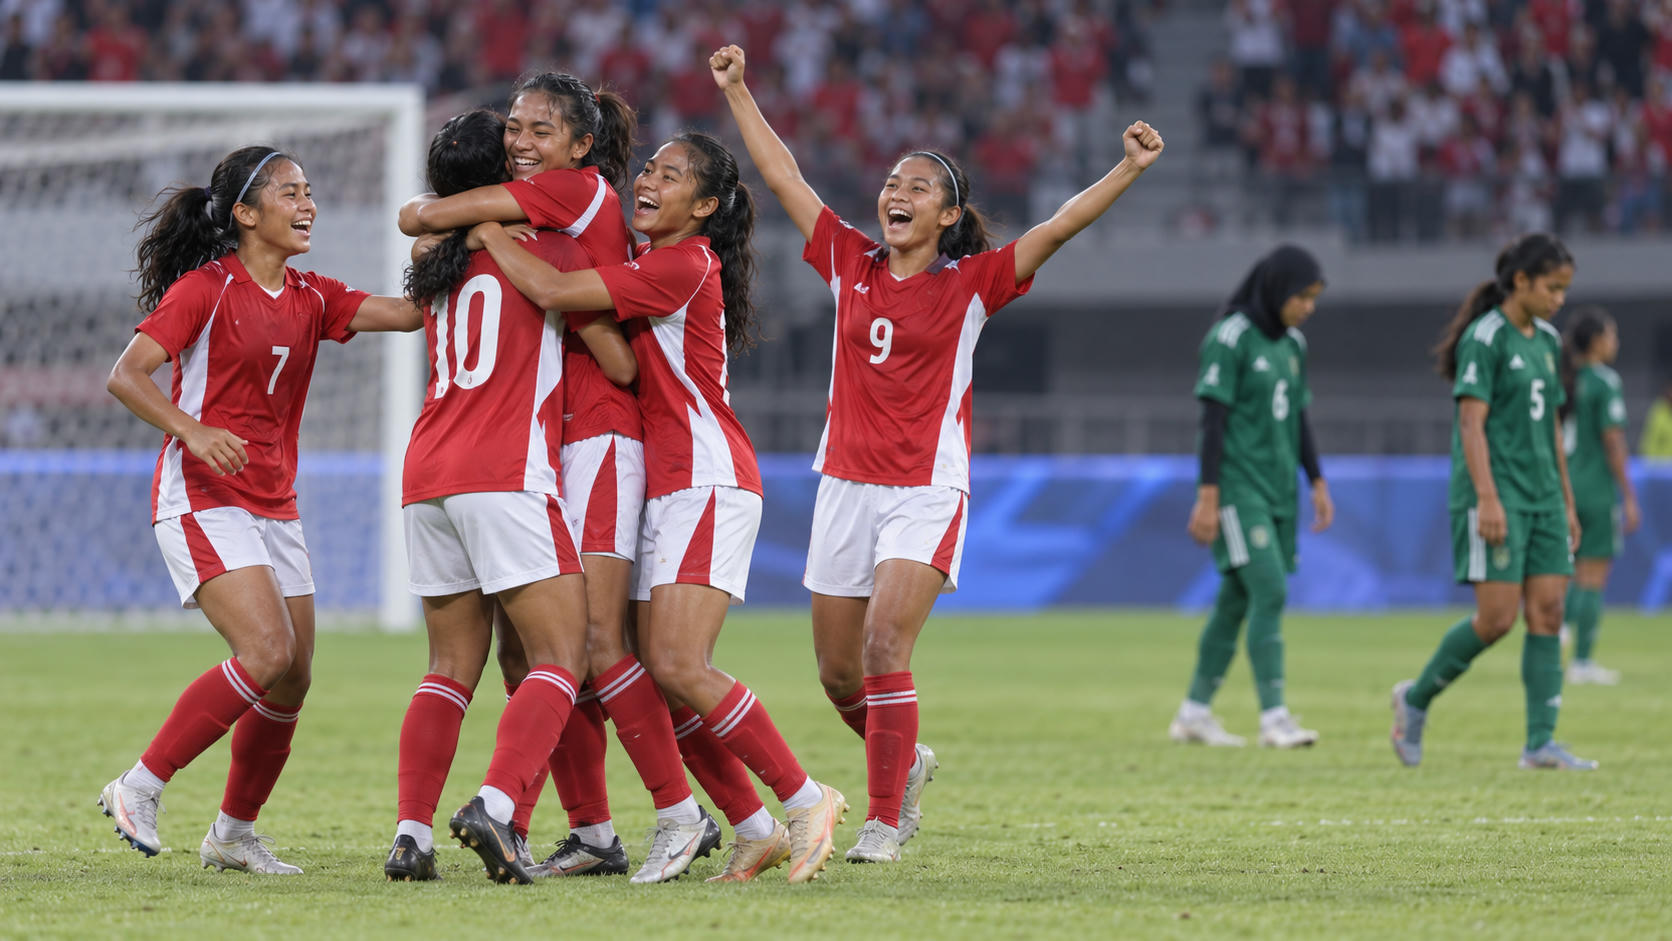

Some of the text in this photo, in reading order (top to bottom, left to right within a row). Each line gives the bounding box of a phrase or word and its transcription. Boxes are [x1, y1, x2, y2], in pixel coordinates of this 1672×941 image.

[431, 274, 502, 399] 10
[869, 317, 894, 364] 9
[267, 345, 290, 395] 7
[1272, 379, 1289, 421] 6
[1530, 378, 1545, 421] 5
